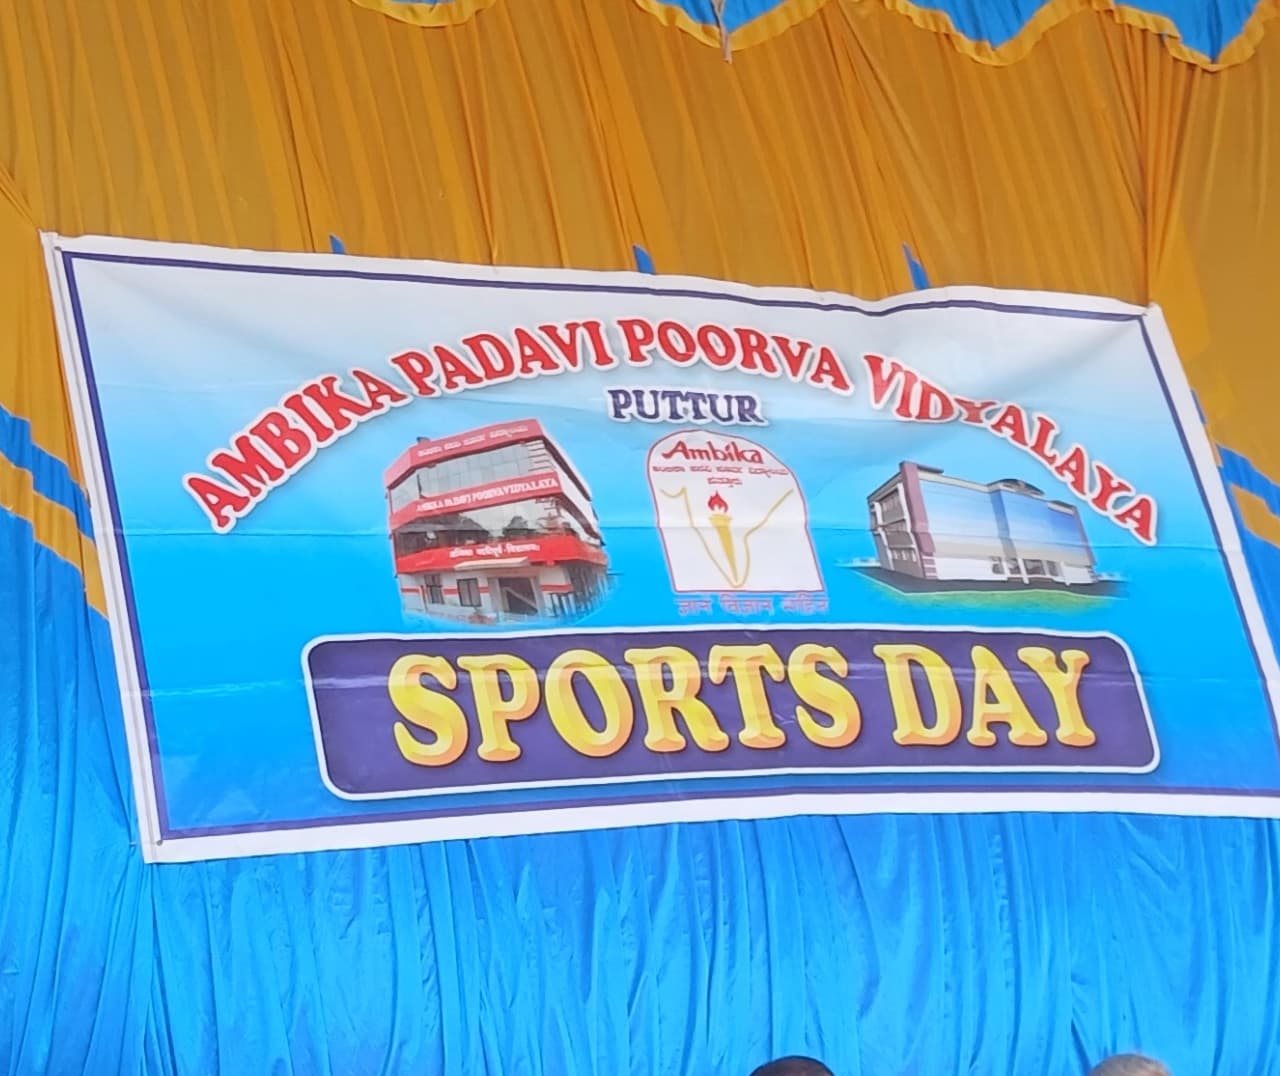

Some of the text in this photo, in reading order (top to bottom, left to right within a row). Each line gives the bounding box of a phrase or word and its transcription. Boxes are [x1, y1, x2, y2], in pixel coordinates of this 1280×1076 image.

[189, 319, 1151, 538] AMBIKA PADAVI POORVA VIDYALAYA
[607, 389, 763, 423] PUTTUR
[661, 440, 764, 464] Ambika
[388, 643, 1096, 766] SPORTS DAY
